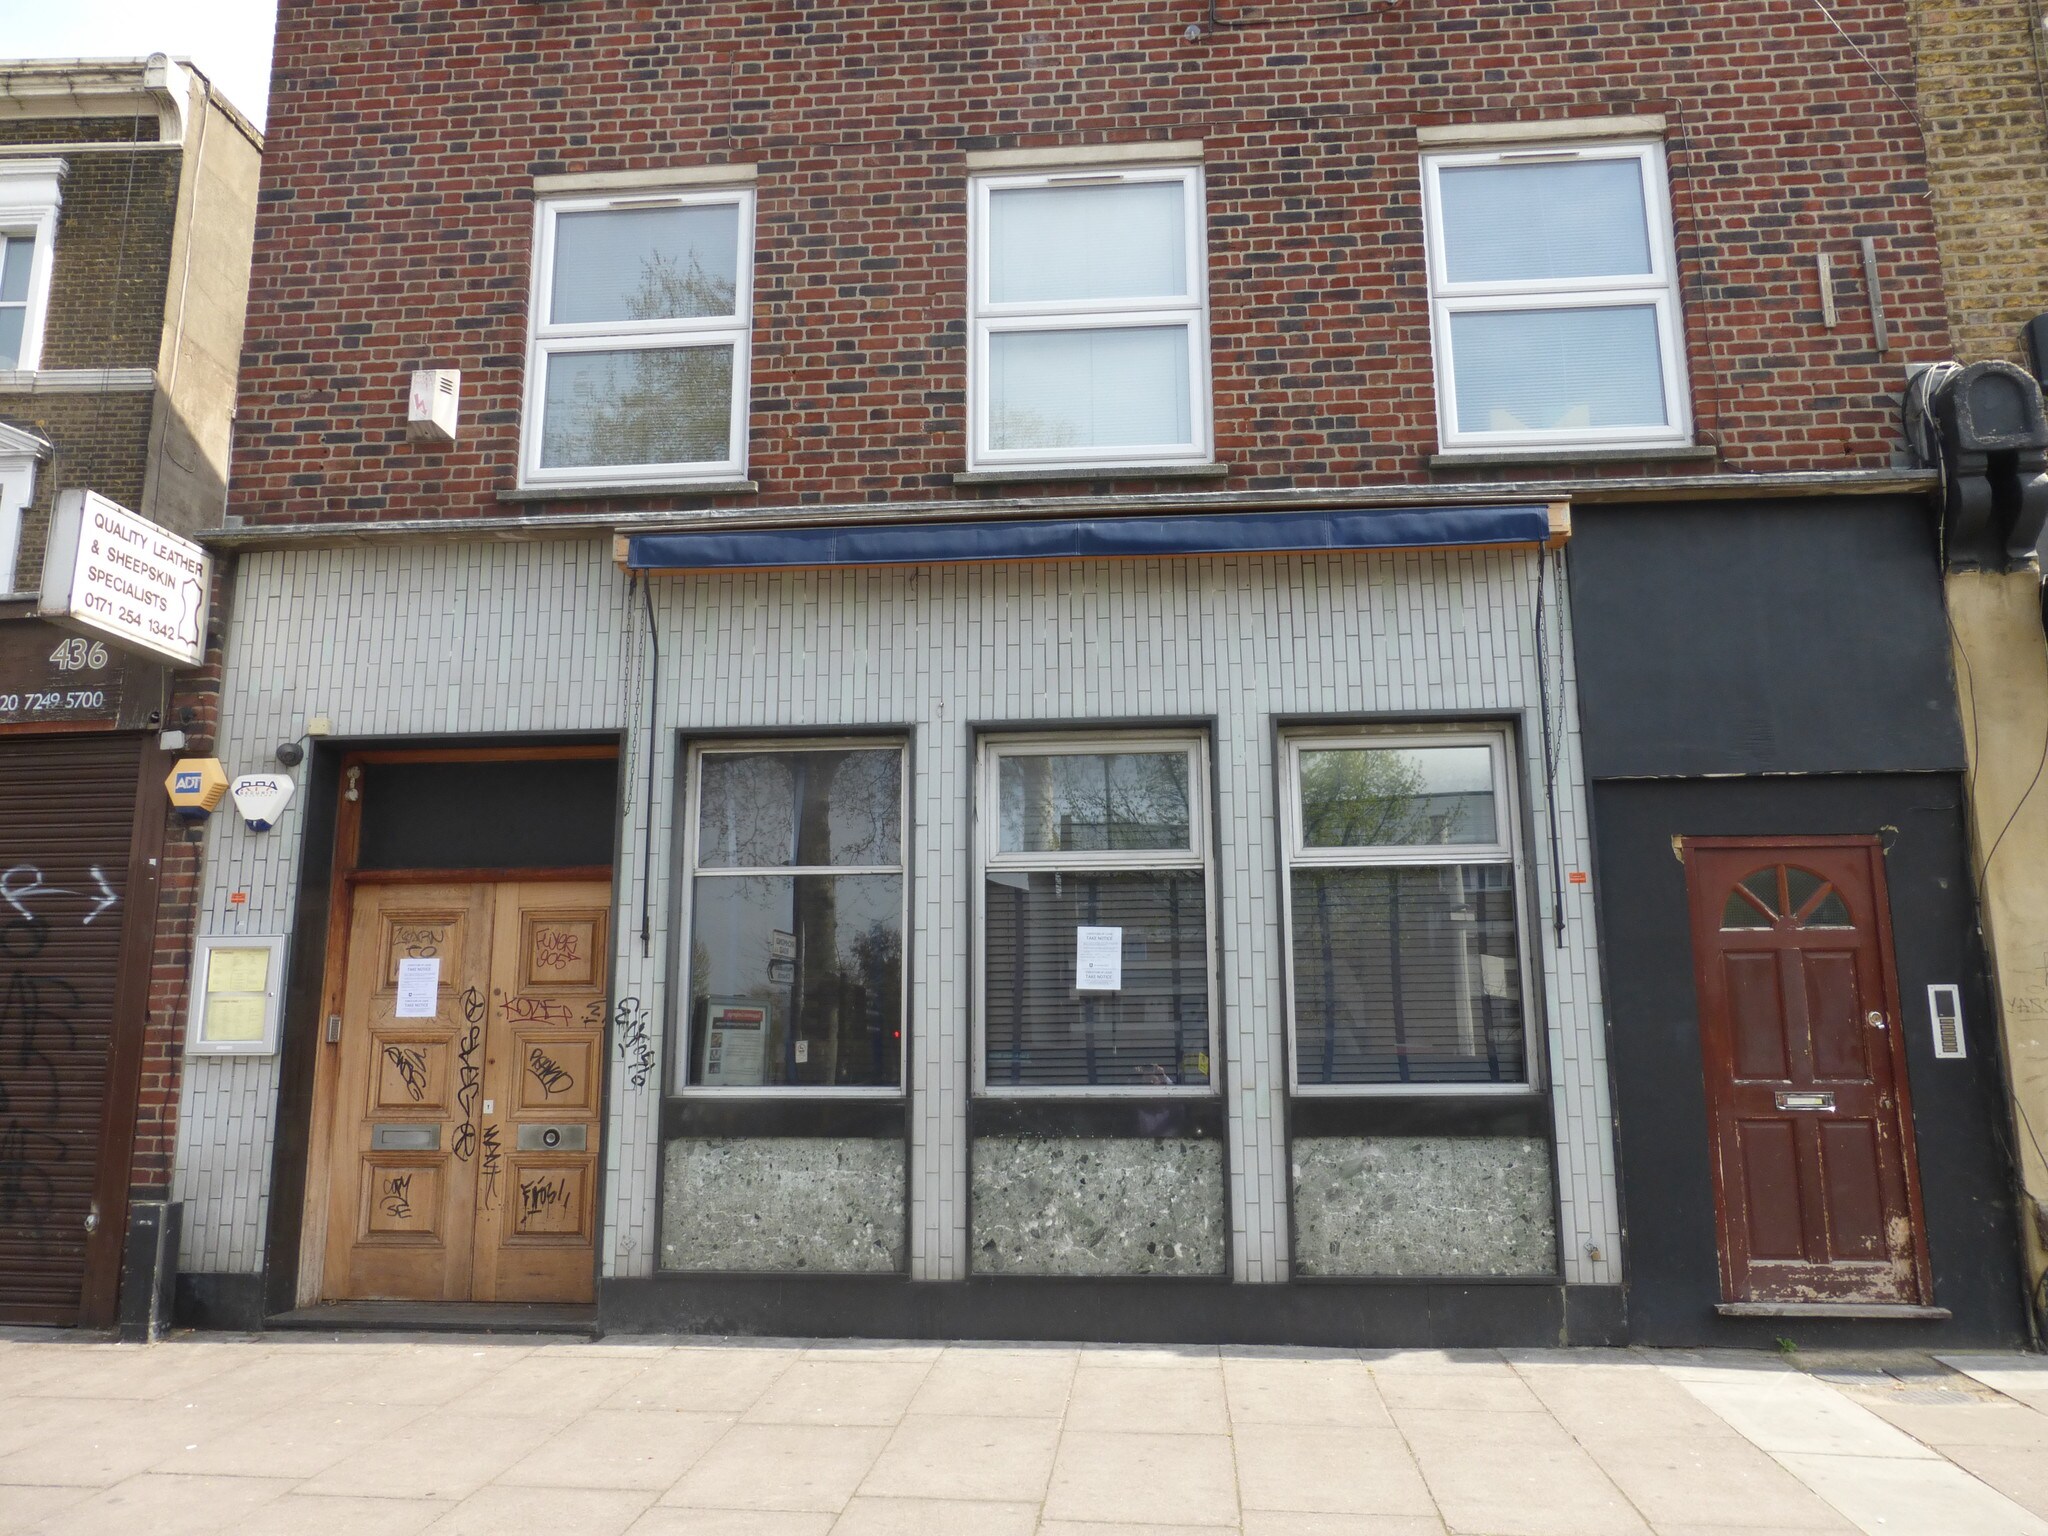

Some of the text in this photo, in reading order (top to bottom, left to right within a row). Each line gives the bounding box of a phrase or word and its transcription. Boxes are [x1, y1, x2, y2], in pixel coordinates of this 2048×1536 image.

[91, 539, 176, 590] & SHEEPSKIN
[94, 513, 203, 578] QUALITY LEATHER
[88, 565, 168, 612] SPECIALISTS
[85, 592, 175, 641] 0171 254 1342
[49, 638, 108, 671] 436
[24, 692, 60, 711] 7249
[64, 691, 104, 709] 5700
[176, 776, 203, 790] ADT
